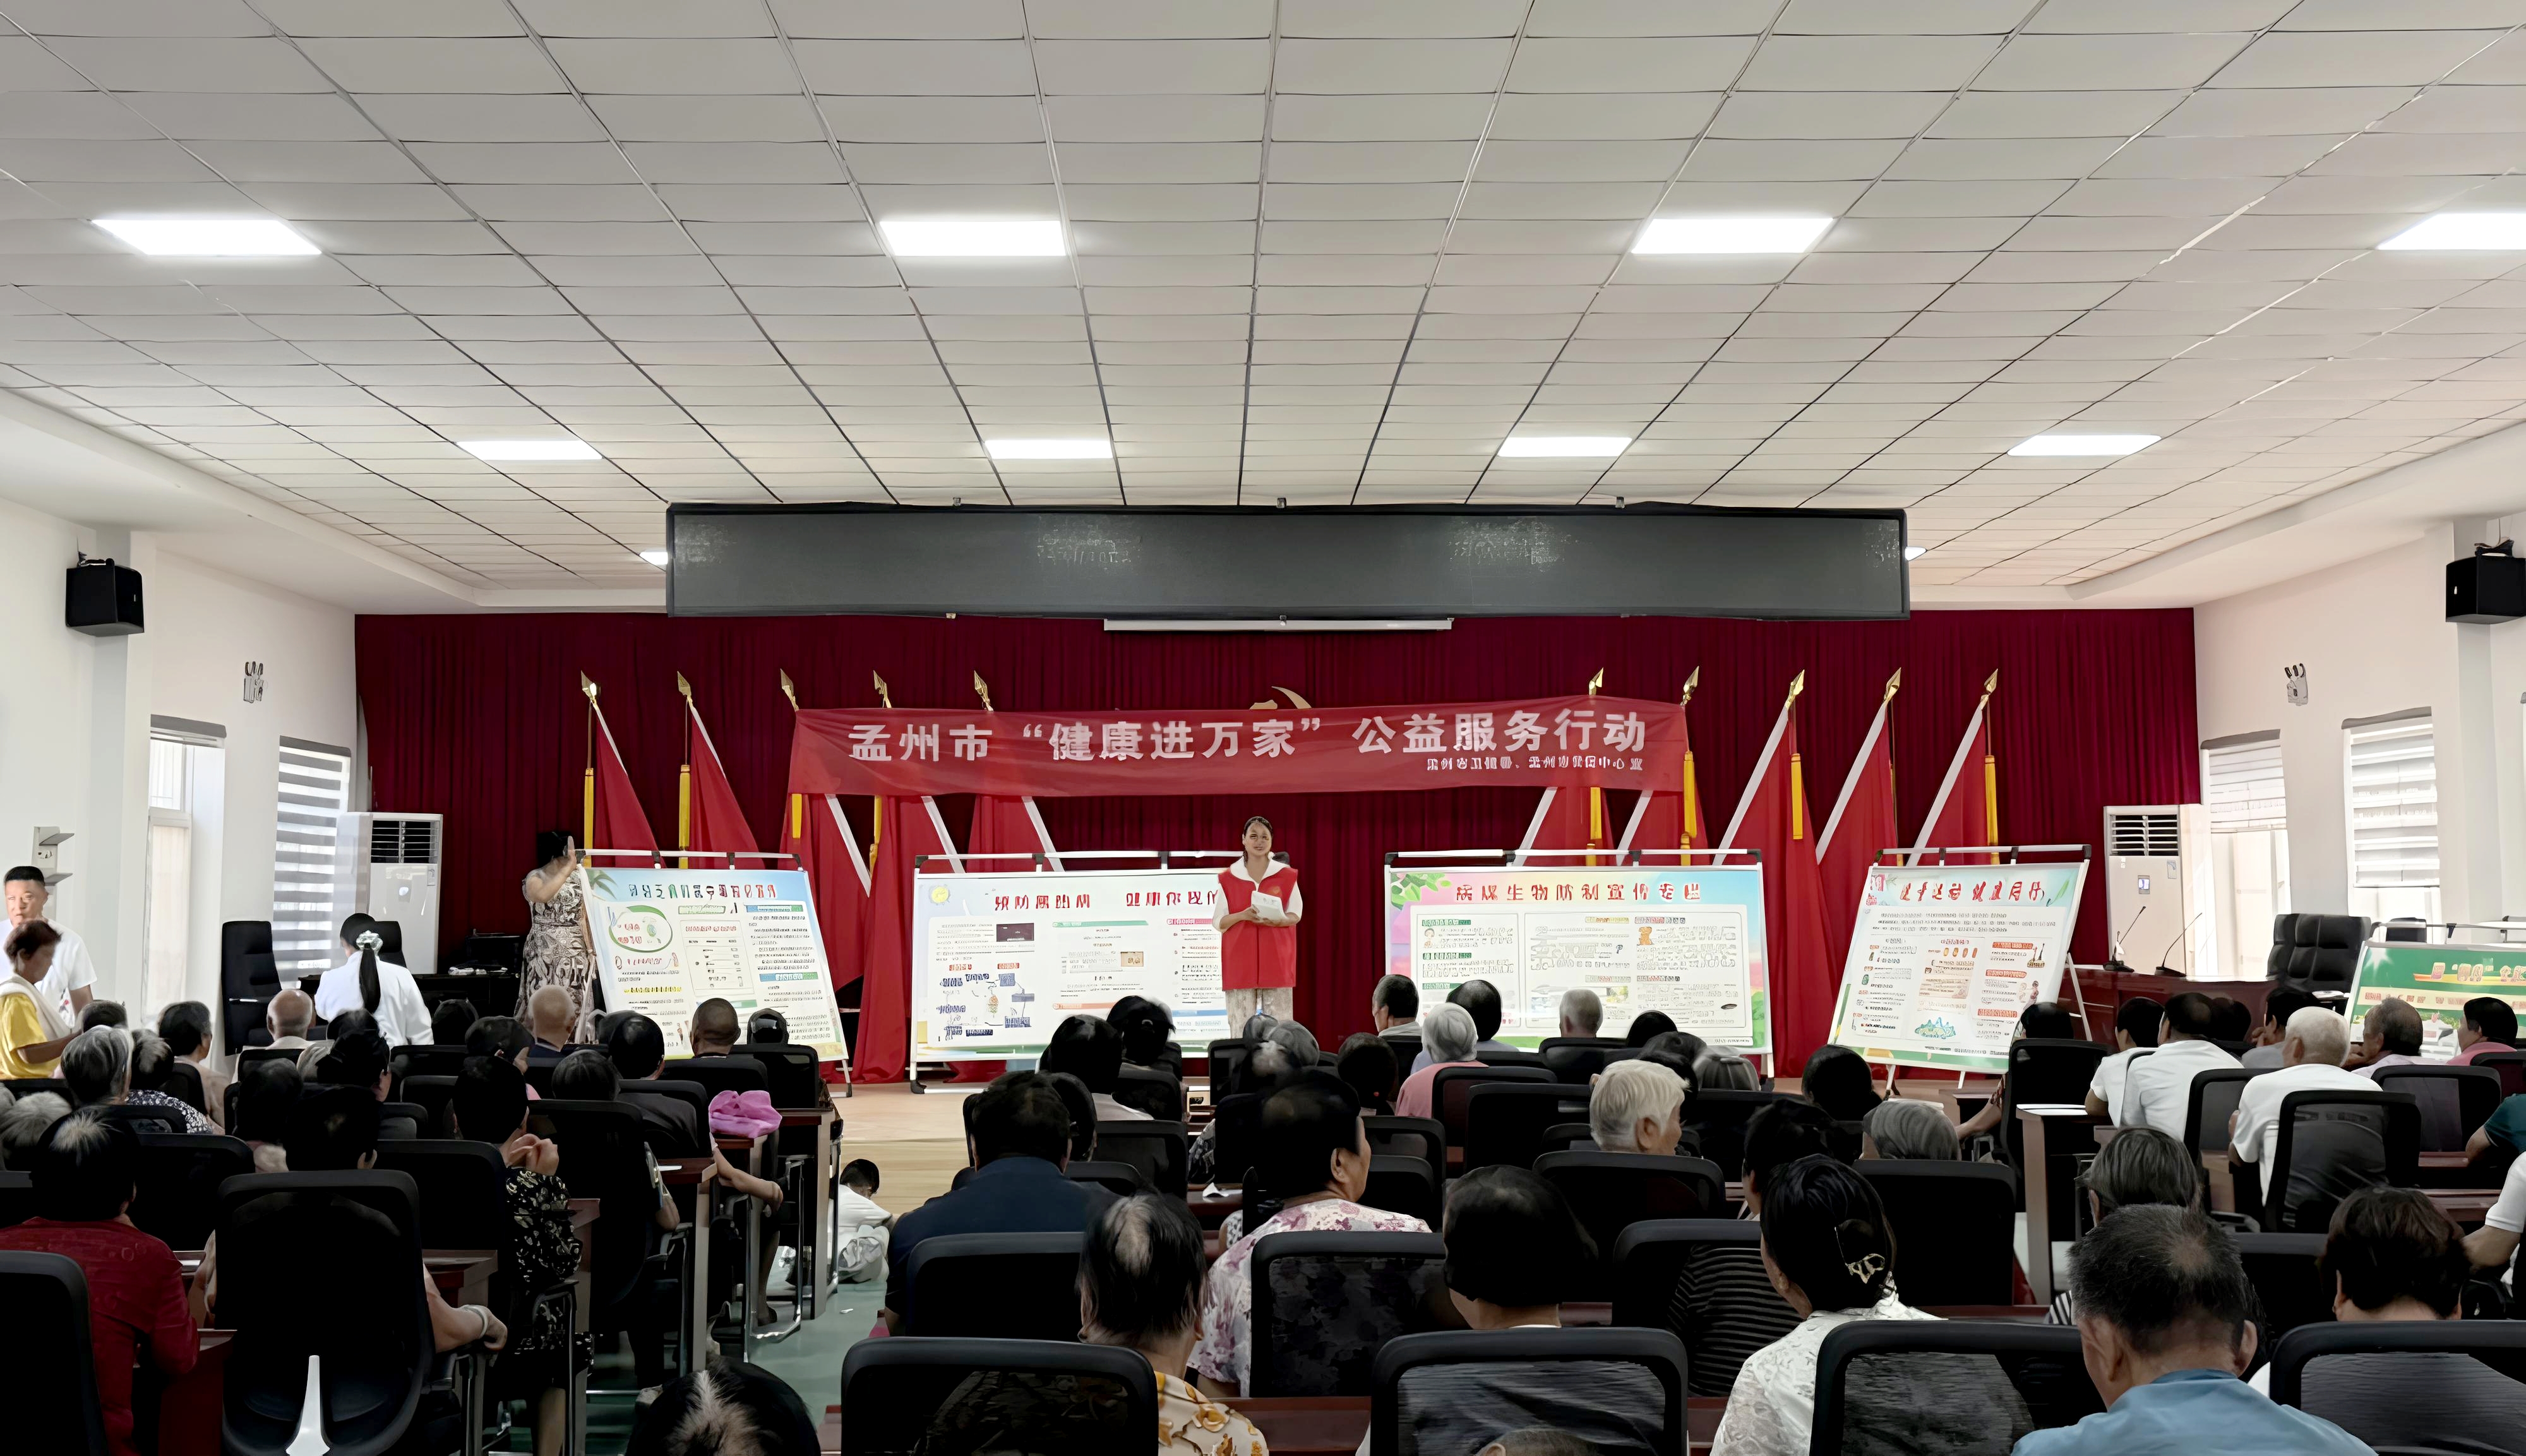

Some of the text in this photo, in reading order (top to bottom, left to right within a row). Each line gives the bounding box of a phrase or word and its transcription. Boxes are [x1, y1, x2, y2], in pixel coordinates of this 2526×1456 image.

[848, 708, 1646, 762] 孟州市 “健康进万家” 公益服务行动
